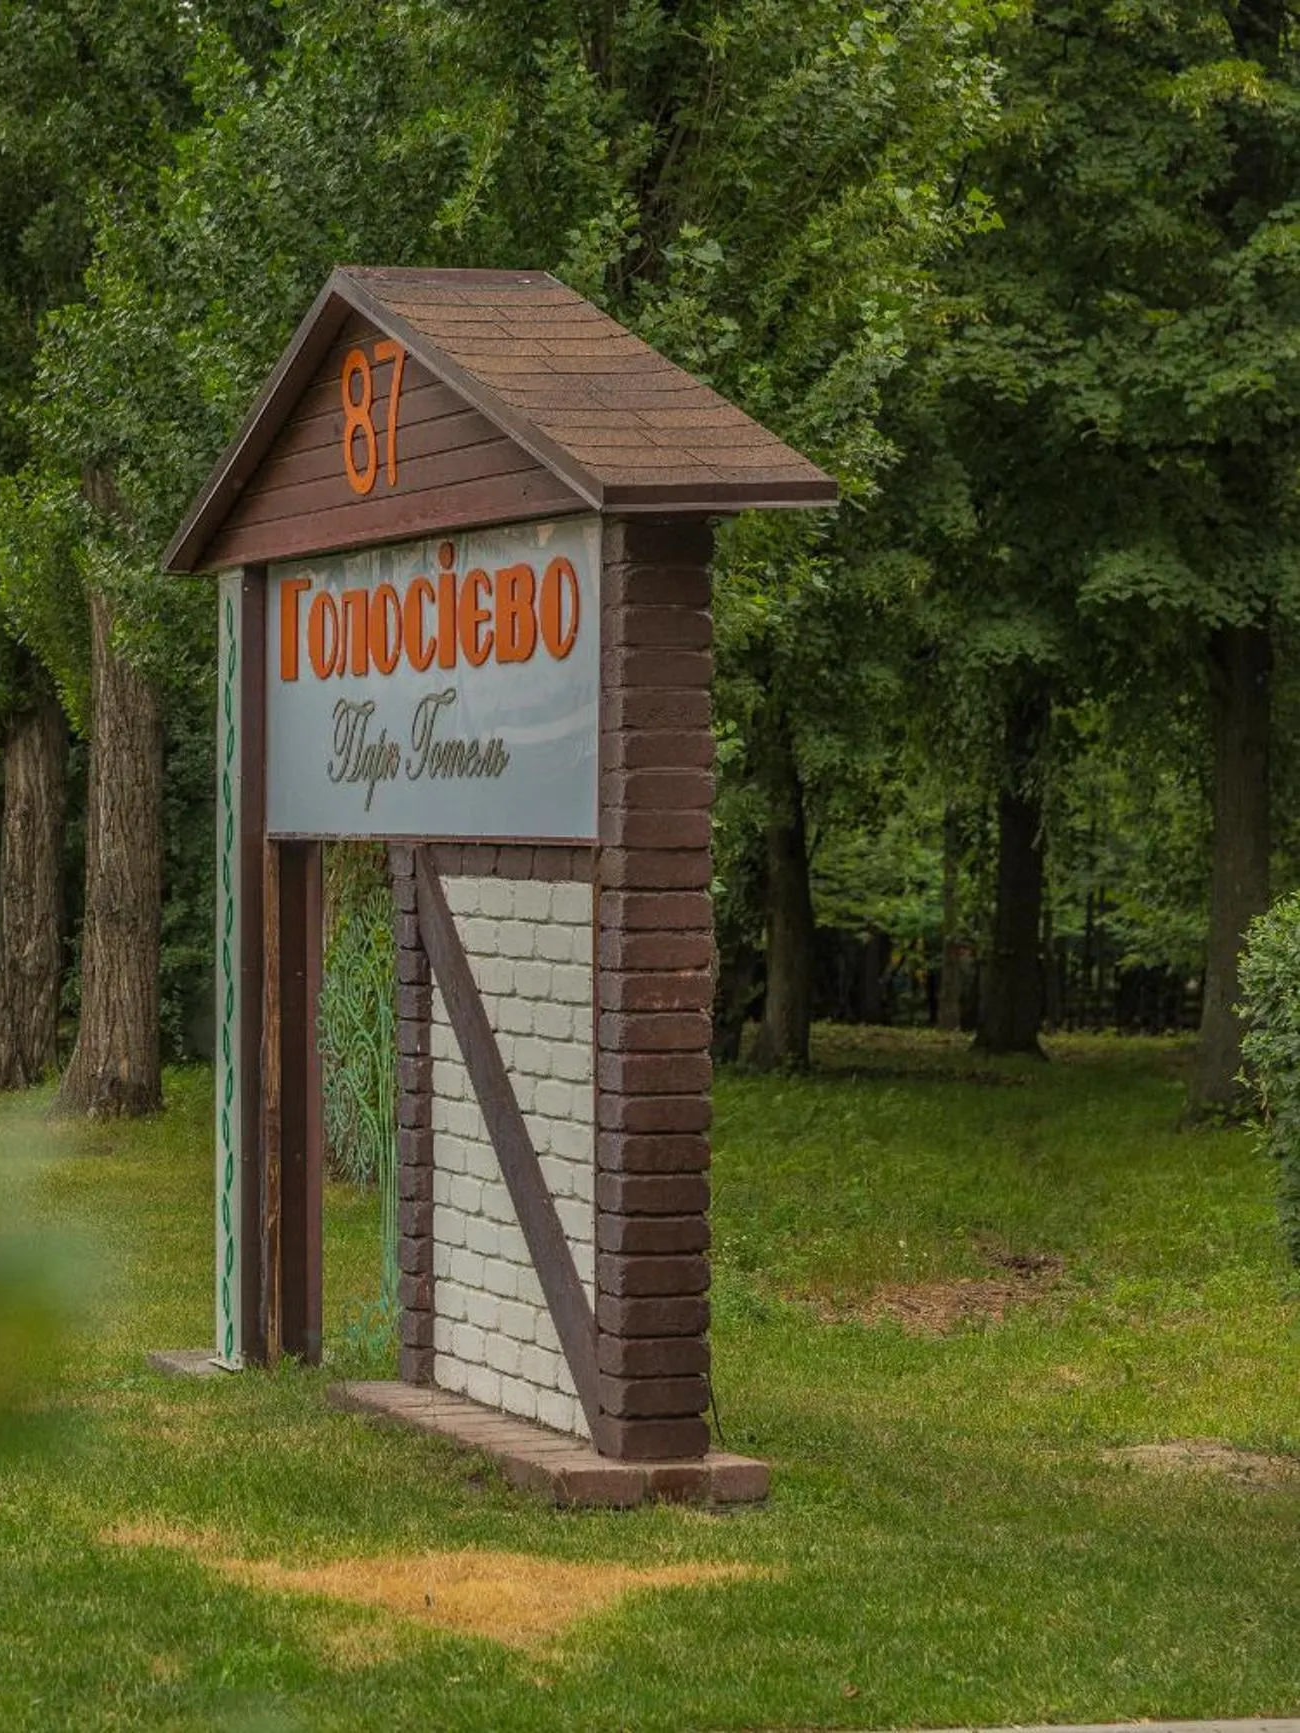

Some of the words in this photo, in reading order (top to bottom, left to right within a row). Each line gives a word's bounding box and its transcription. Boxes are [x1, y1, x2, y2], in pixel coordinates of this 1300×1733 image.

[343, 342, 406, 494] 87
[327, 698, 401, 813] Парк
[406, 688, 510, 781] Готель
